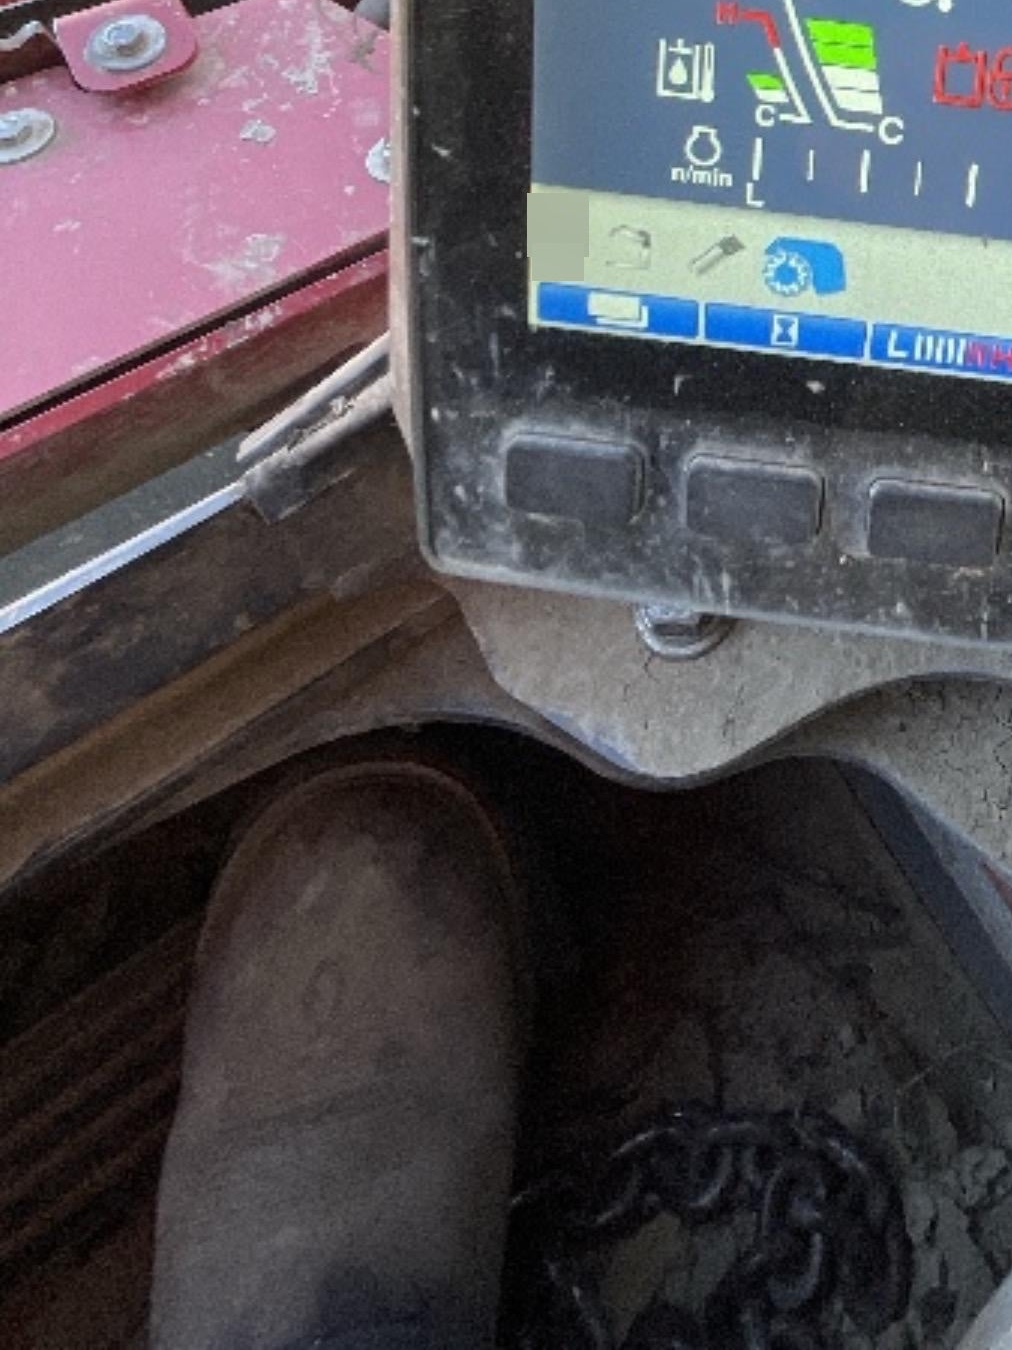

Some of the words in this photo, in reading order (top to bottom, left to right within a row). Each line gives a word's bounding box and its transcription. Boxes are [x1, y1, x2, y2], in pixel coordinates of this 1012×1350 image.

[755, 104, 777, 127] C
[878, 116, 905, 145] C
[671, 166, 734, 188] n/min
[746, 182, 766, 209] L
